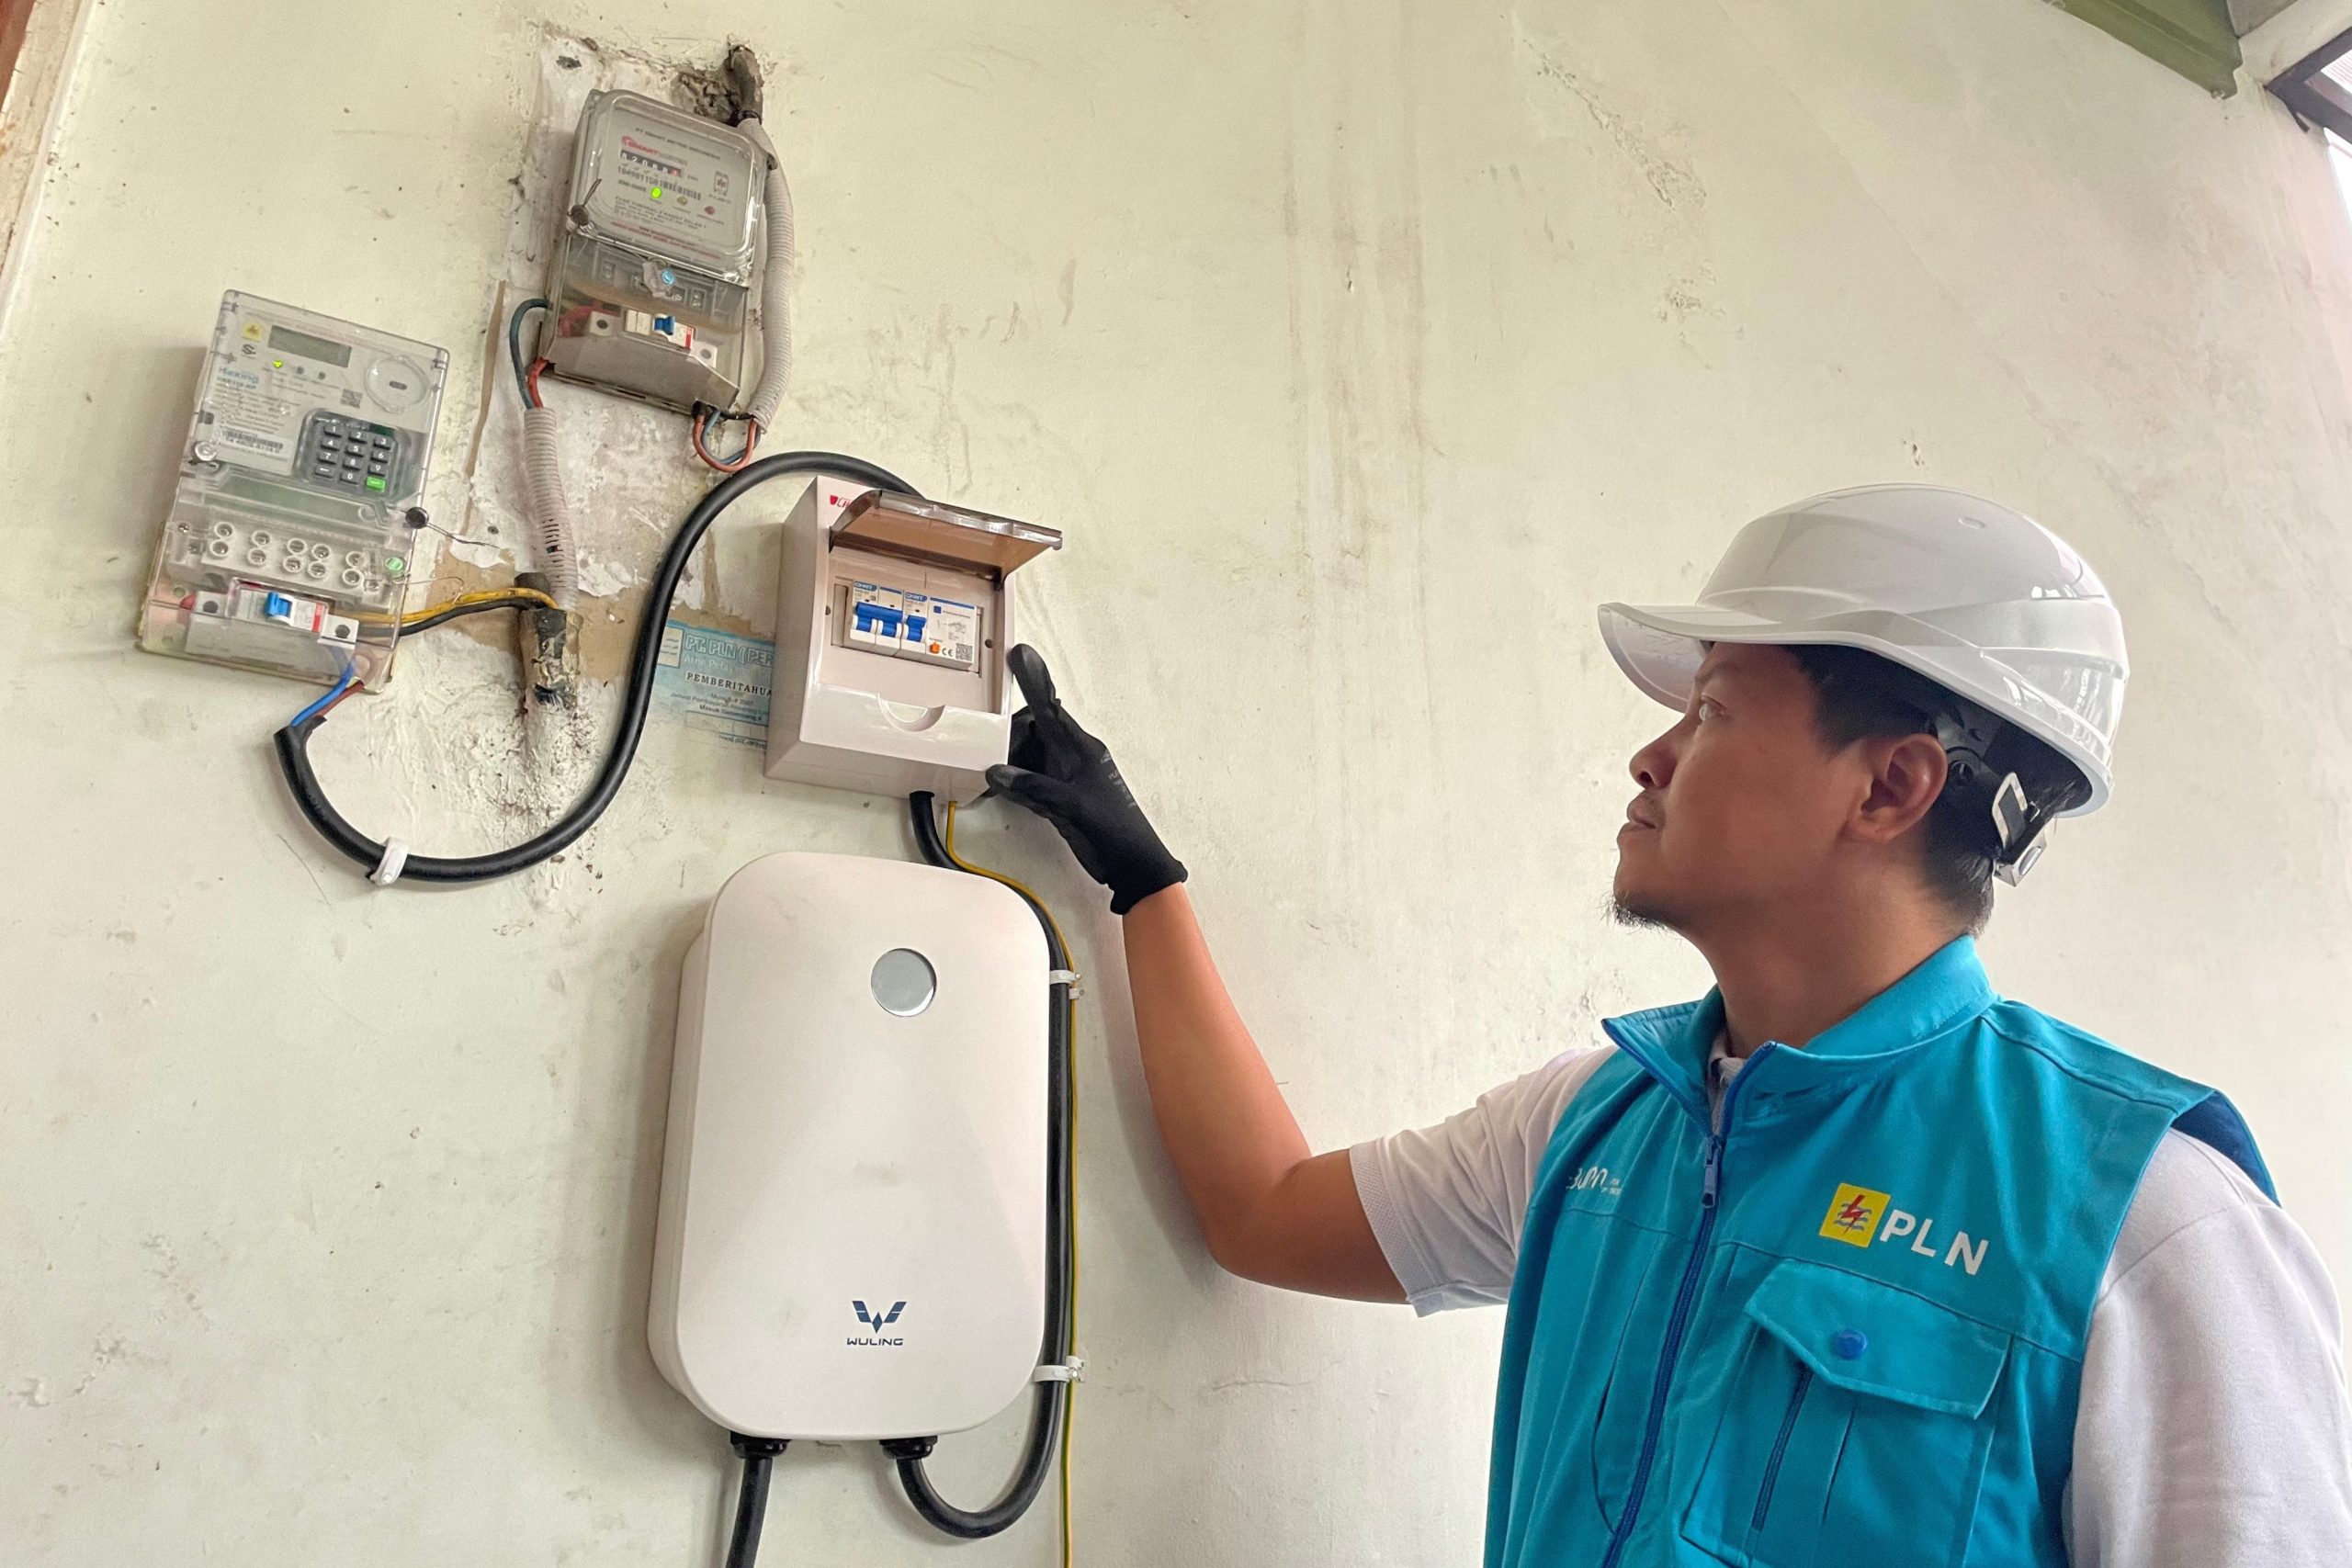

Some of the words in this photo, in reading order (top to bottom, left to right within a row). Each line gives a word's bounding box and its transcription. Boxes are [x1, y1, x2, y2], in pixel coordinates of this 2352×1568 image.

[356, 431, 362, 439] 2
[347, 472, 354, 480] 0
[684, 634, 707, 654] PT.
[708, 638, 737, 660] PLN
[942, 647, 954, 658] CE
[1880, 1209, 1989, 1276] PLN
[846, 1337, 904, 1347] WULING
